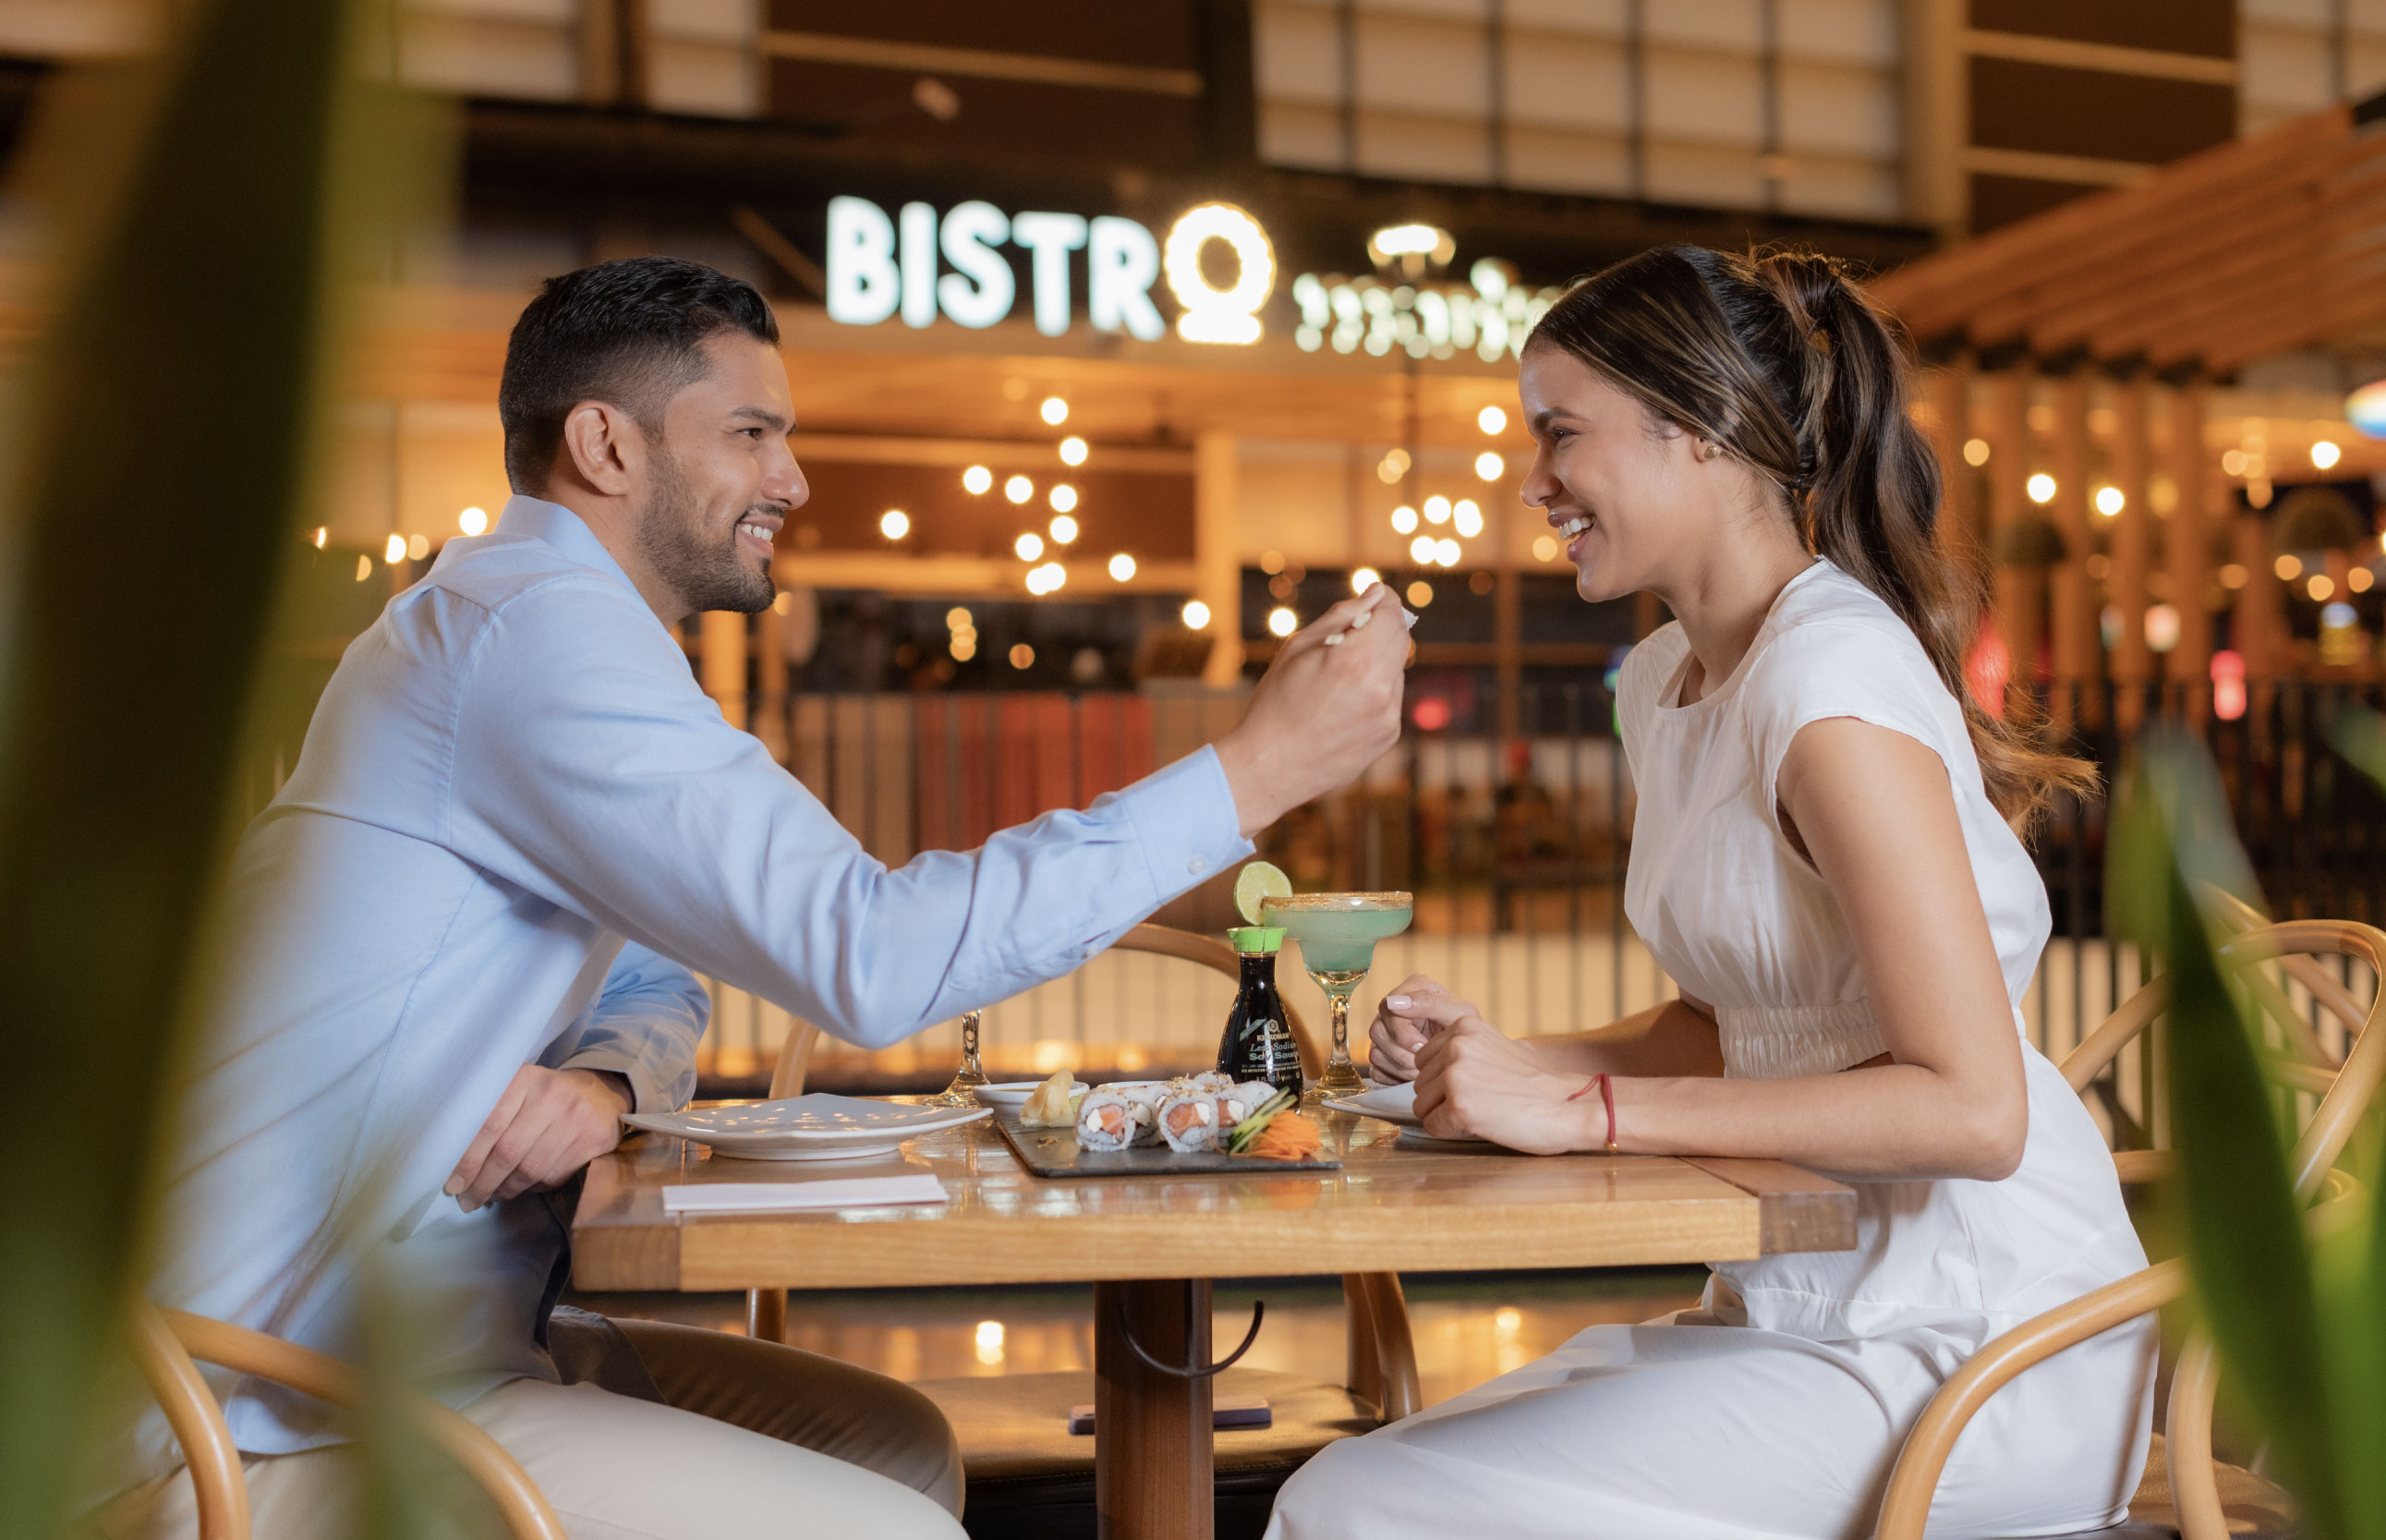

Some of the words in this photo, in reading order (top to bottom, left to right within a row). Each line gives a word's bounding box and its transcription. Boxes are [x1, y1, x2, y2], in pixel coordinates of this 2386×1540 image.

[827, 194, 1277, 346] BISTRO
[1249, 1043, 1269, 1051] Less
[1249, 1052, 1271, 1061] Soy
